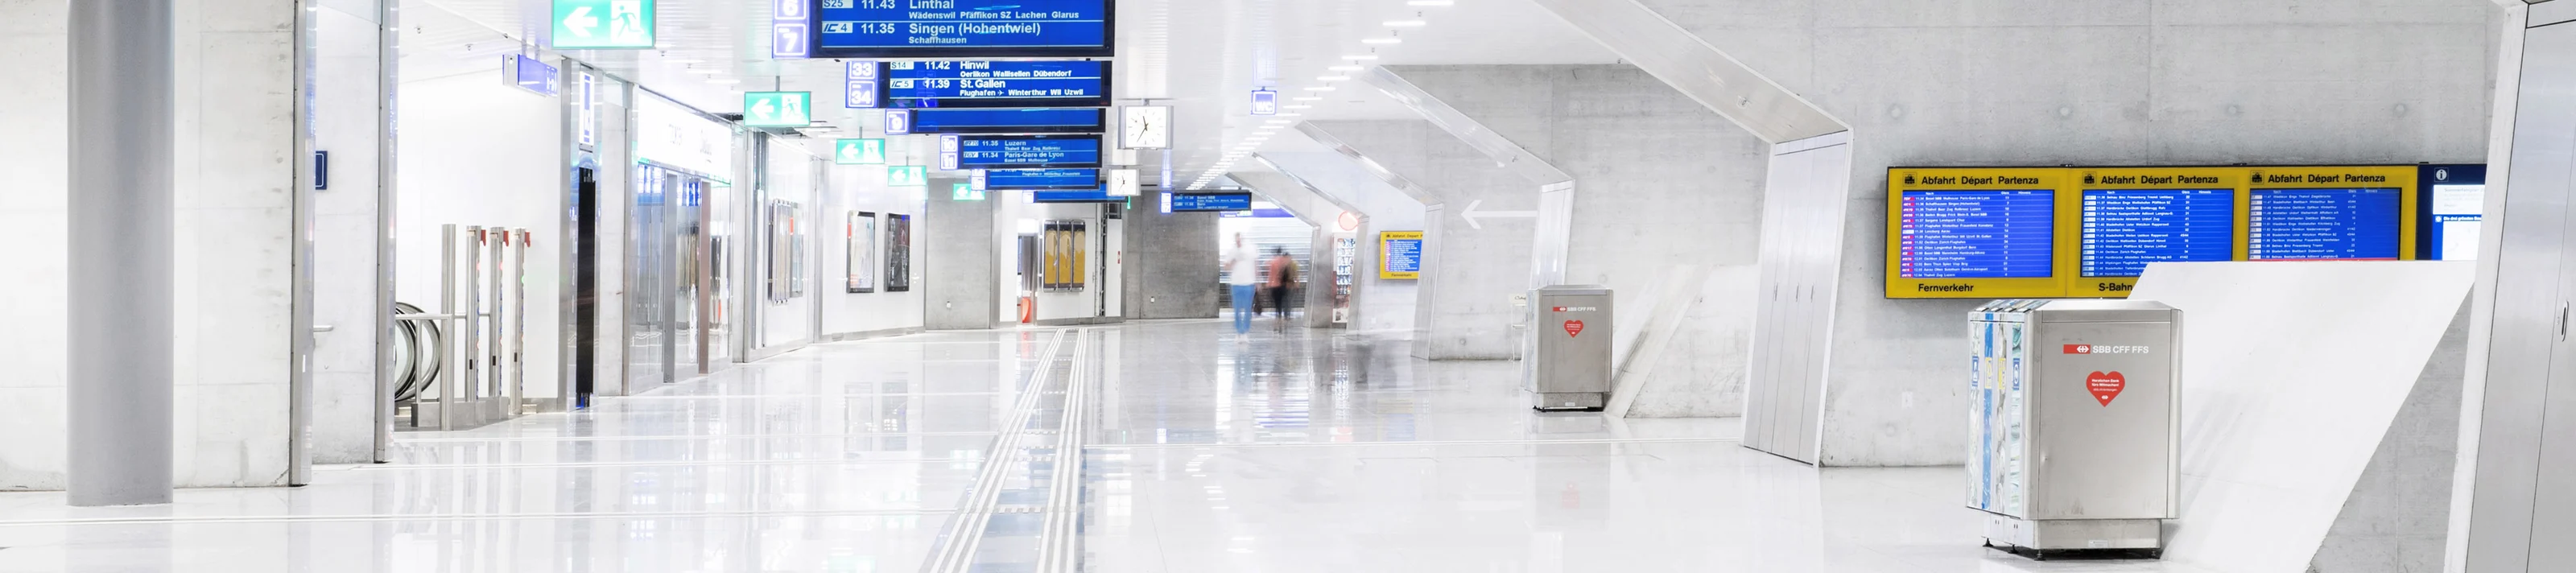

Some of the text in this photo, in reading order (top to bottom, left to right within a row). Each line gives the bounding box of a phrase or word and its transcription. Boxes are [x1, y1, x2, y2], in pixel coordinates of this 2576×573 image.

[782, 0, 796, 16] 6
[862, 0, 895, 9] 11.43
[910, 0, 953, 9] Linthal
[861, 23, 894, 33] 11.35
[910, 23, 954, 36] Singen
[959, 23, 1040, 35] (Hohentwiel)
[783, 32, 797, 52] 7
[853, 63, 872, 76] 33
[924, 61, 951, 70] 11.42
[960, 61, 989, 70] Hinwil
[924, 79, 950, 88] 11.39
[960, 79, 975, 88] St.
[976, 79, 1006, 88] Gallen
[852, 89, 872, 103] 34
[960, 89, 996, 97] Flughafen
[1255, 101, 1273, 111] WC
[891, 117, 902, 130] 9
[1922, 176, 2038, 186] Abfahrt Départ Partenza
[2141, 175, 2172, 185] Départ
[2178, 175, 2218, 183] Partenza
[2268, 174, 2385, 183] Abfahrt Départ Partenza
[2099, 283, 2132, 291] S-Bahn
